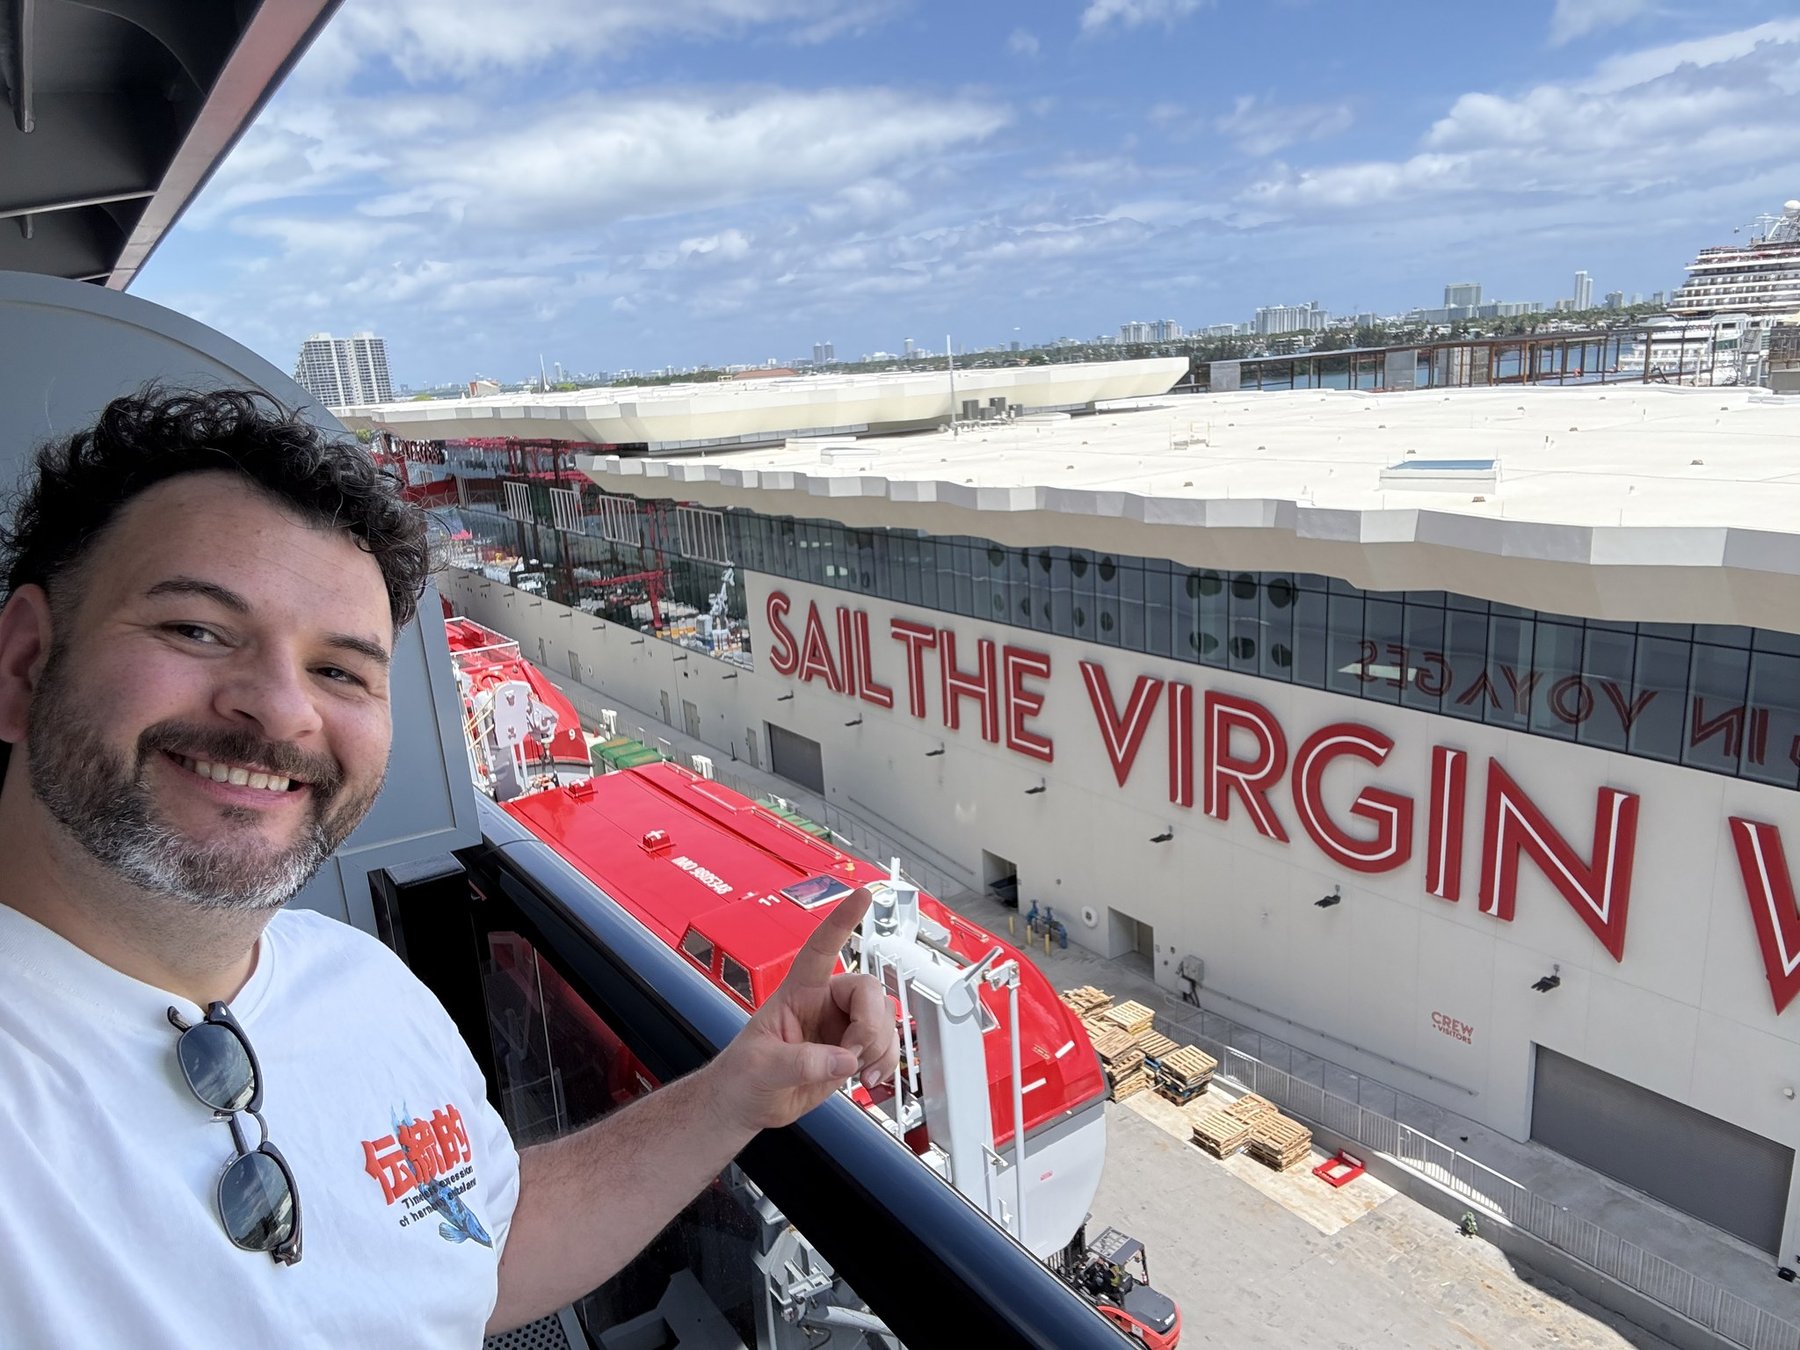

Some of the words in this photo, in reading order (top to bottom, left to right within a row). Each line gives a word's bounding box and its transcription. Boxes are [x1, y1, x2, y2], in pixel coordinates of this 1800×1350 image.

[568, 728, 576, 741] 9
[766, 590, 893, 709] SAIL
[890, 618, 1054, 763] THE
[1079, 660, 1640, 963] VIRGIN
[1431, 1011, 1474, 1037] CREW
[1438, 1025, 1472, 1045] VISITORS
[399, 1215, 409, 1227] of
